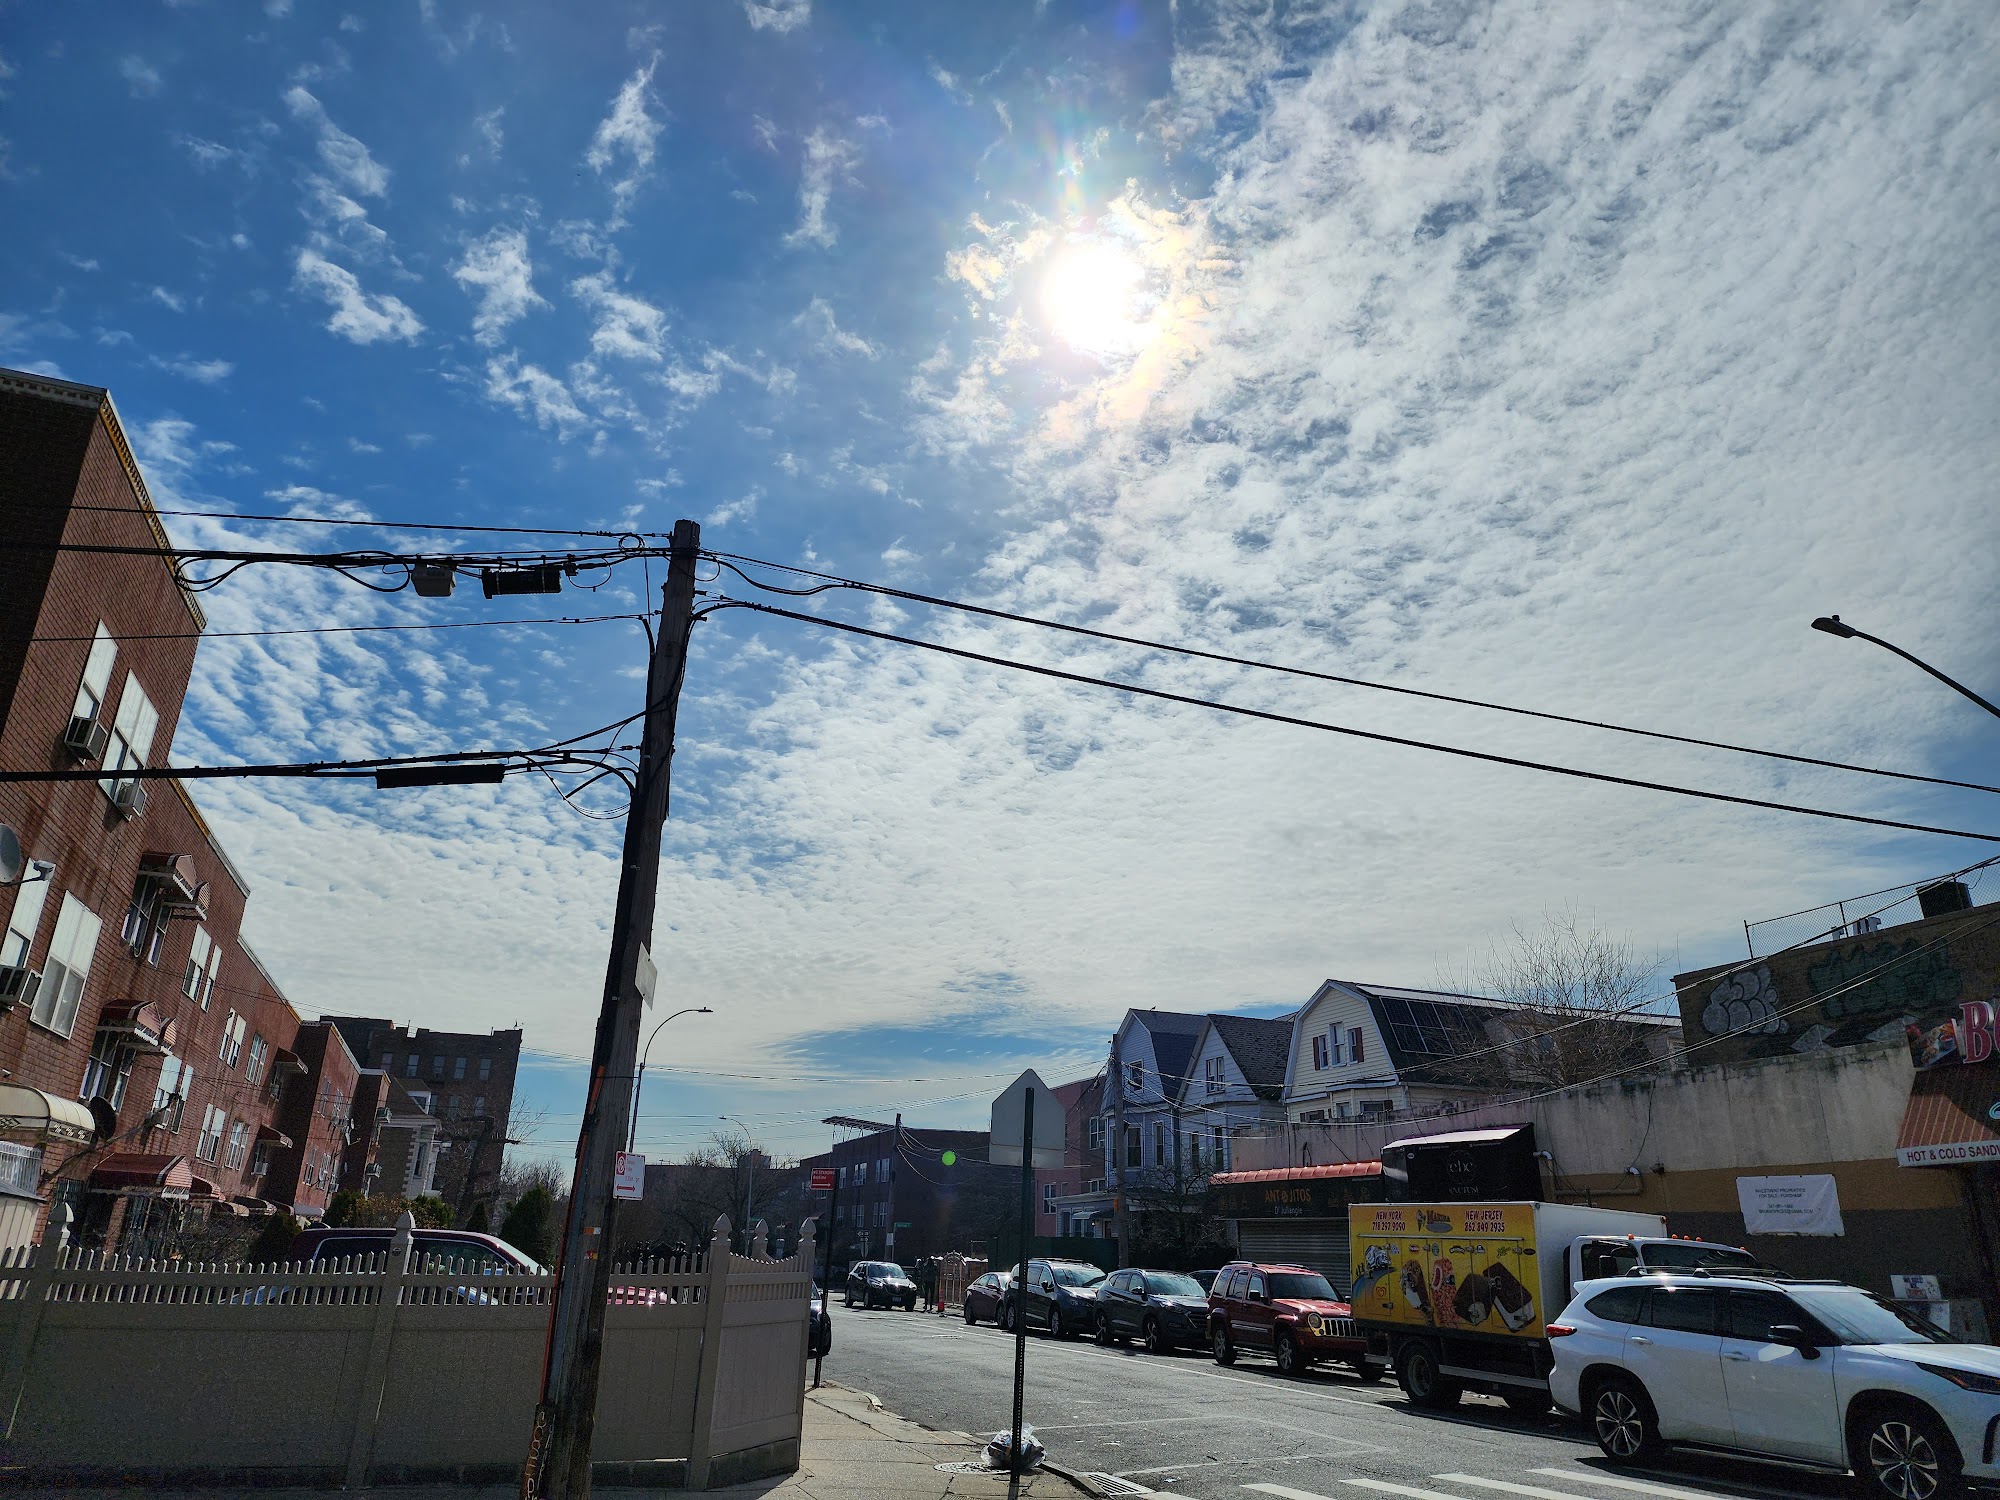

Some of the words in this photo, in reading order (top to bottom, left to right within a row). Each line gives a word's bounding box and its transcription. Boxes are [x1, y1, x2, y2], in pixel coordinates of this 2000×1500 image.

[1959, 1001, 2000, 1064] B
[1907, 1150, 1926, 1162] HOT
[1929, 1149, 1937, 1160] &
[1938, 1147, 1966, 1160] COLD
[1375, 1211, 1388, 1220] NEW
[1388, 1210, 1403, 1220] YORK
[1465, 1210, 1480, 1220] NEW
[1480, 1210, 1503, 1220] JERSEY
[1372, 1221, 1381, 1230] 718
